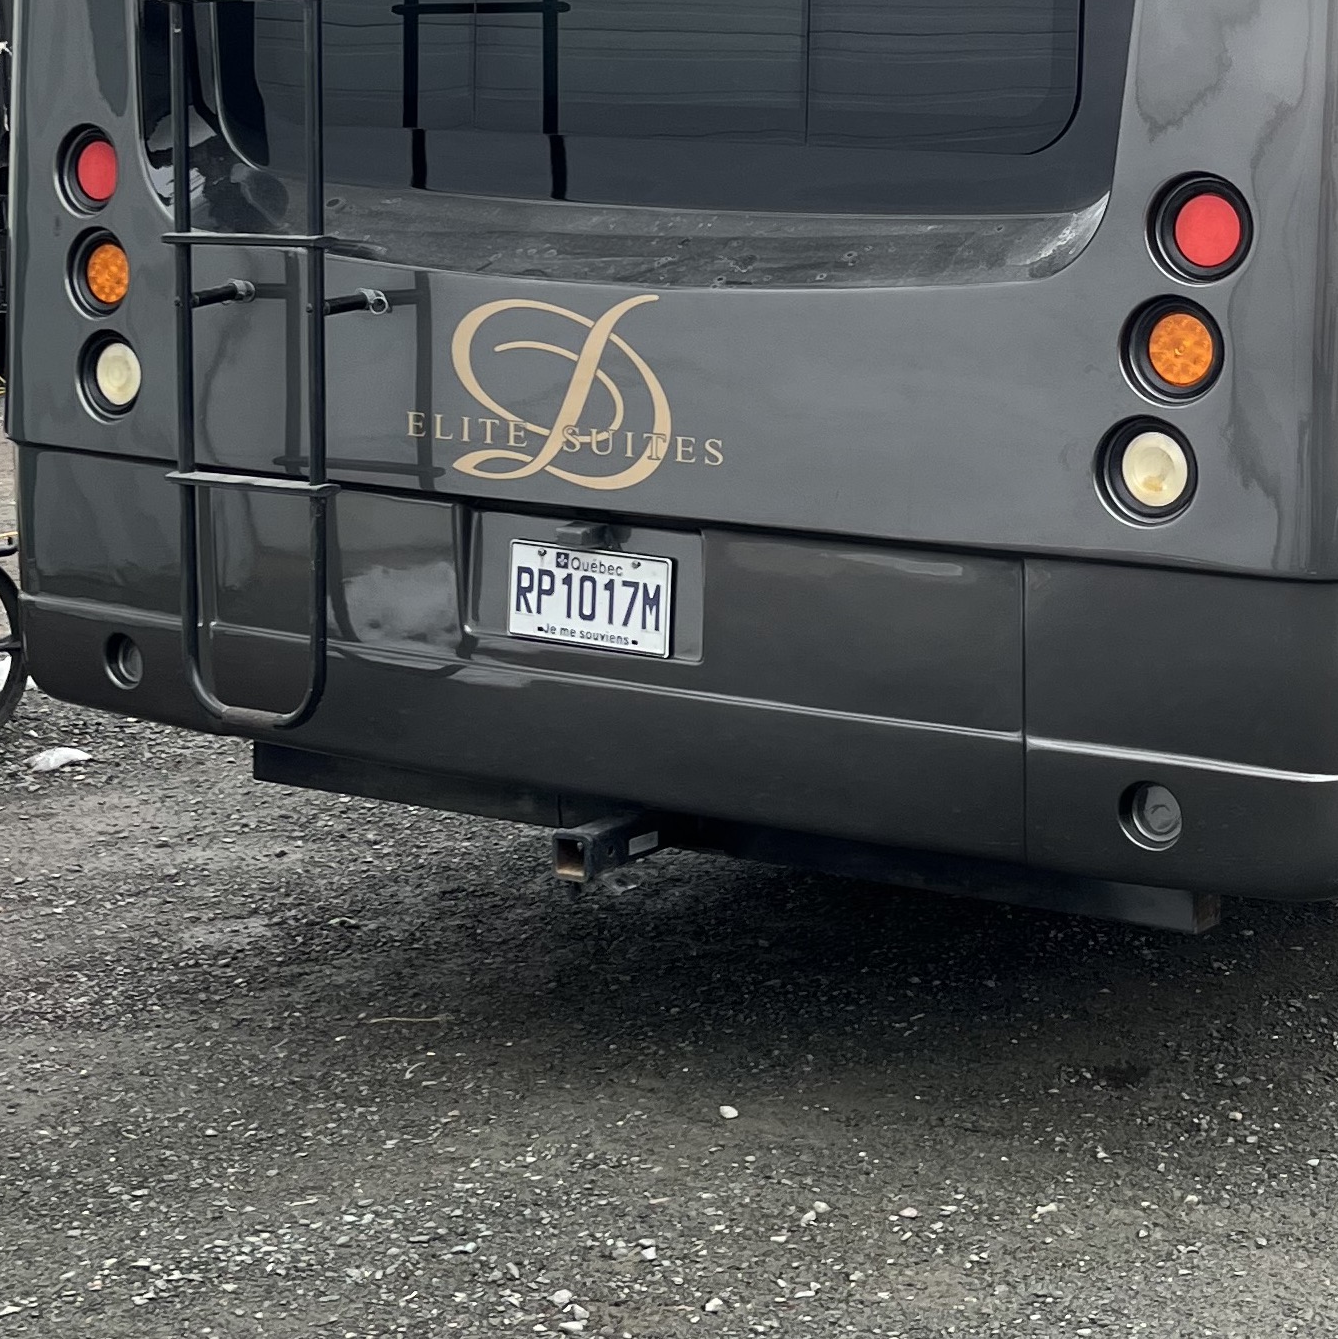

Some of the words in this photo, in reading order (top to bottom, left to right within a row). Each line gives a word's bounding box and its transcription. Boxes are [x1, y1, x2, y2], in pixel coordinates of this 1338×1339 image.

[406, 411, 528, 449] ELITE
[561, 425, 725, 466] SUITES
[570, 556, 623, 577] Québec
[516, 566, 661, 631] RP1017M
[544, 624, 557, 635] Je
[560, 627, 576, 638] me
[579, 629, 630, 646] souviens
